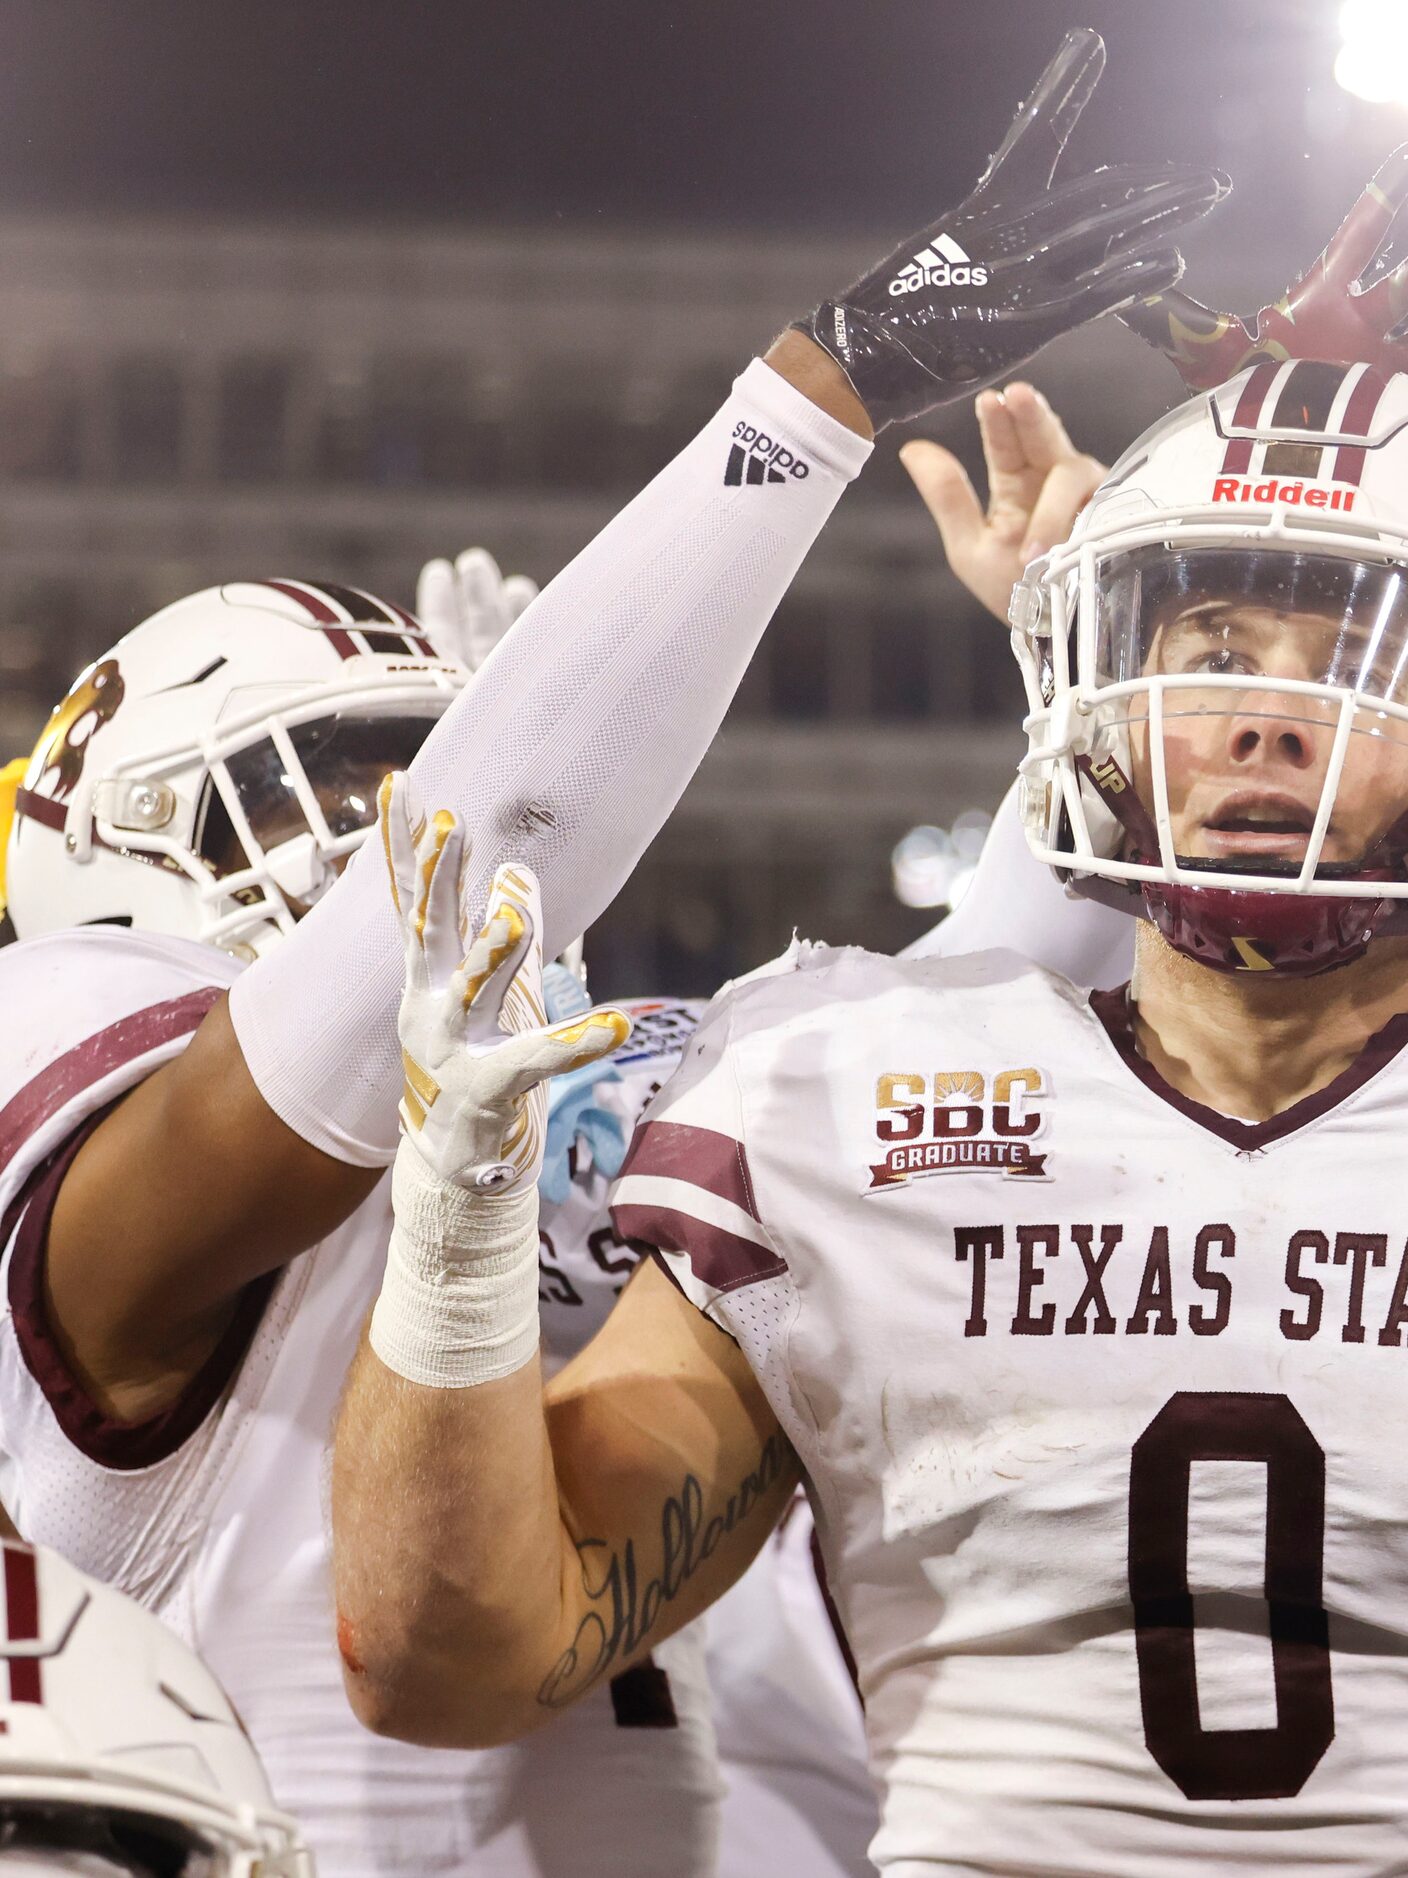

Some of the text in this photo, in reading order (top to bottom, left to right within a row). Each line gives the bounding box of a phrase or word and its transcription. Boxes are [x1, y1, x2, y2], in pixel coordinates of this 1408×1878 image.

[888, 263, 988, 297] adidas
[834, 306, 848, 348] ADIZERO
[732, 421, 810, 480] adidas
[1211, 479, 1356, 513] Riddell
[876, 1066, 1043, 1141] SBC
[891, 1142, 1025, 1171] GRADUATE
[954, 1223, 1236, 1337] TEXAS
[1127, 1390, 1336, 1801] 0
